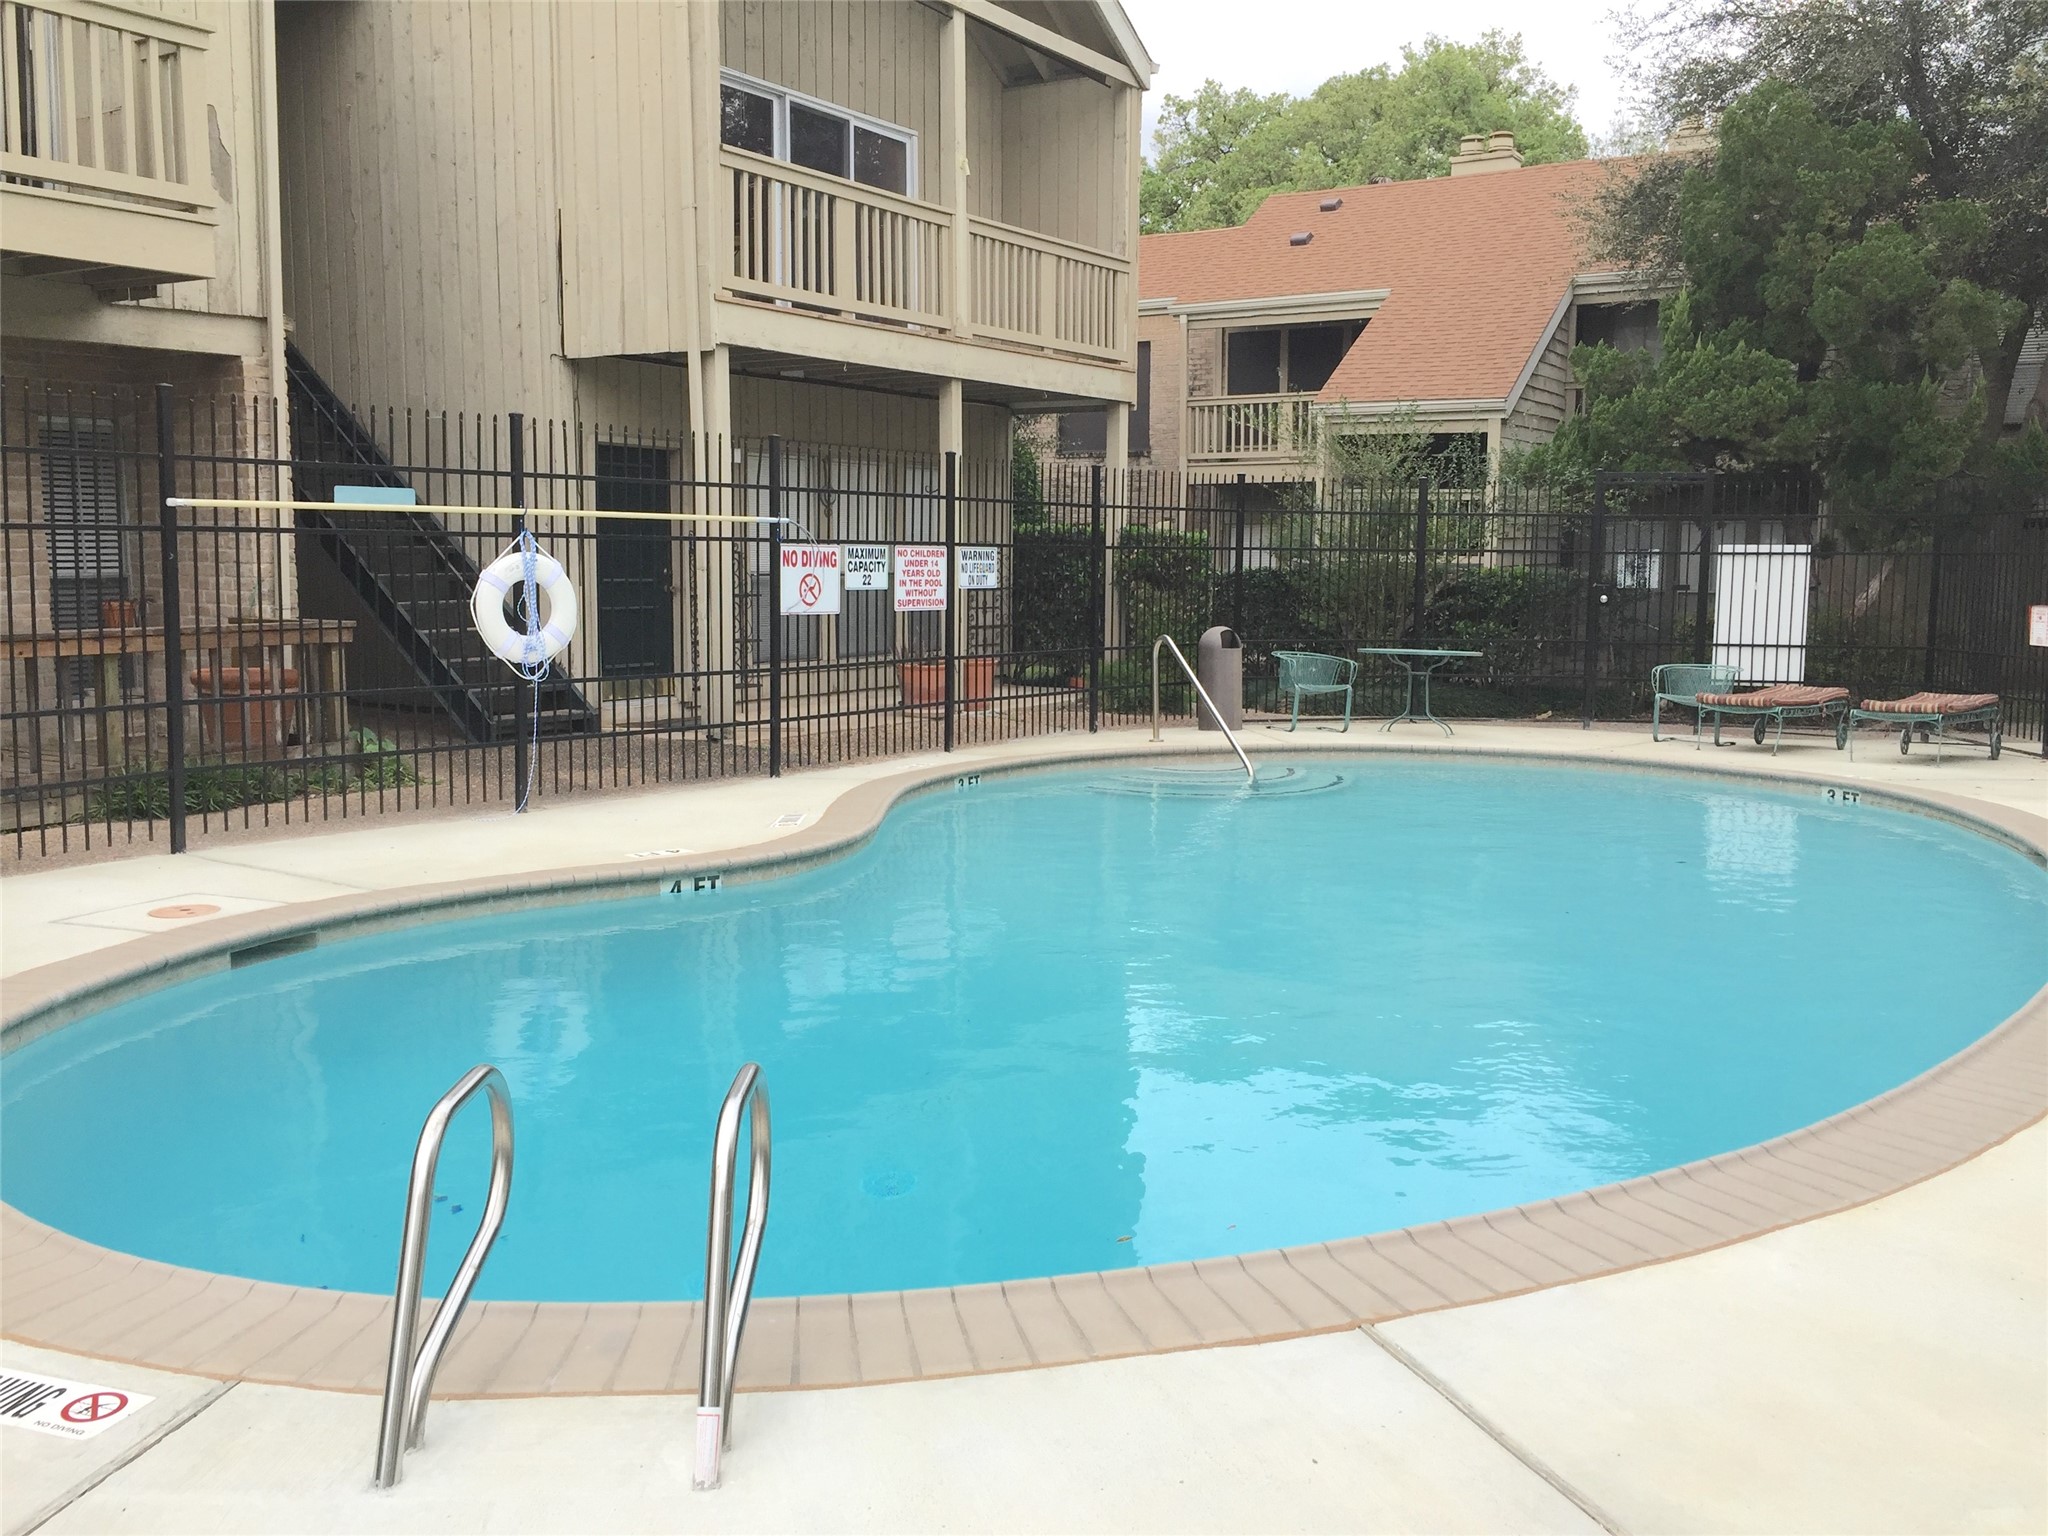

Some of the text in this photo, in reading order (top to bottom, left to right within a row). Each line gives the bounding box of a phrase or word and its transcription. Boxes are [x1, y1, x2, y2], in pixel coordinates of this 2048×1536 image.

[782, 550, 837, 568] NO DIVING
[847, 548, 886, 560] MAXIMUM
[897, 549, 945, 558] NO CHILDREN
[961, 550, 995, 561] WARNING
[847, 561, 887, 573] CAPACITY
[904, 560, 939, 568] UNDER 14
[961, 562, 995, 573] NO LIFEGUARD
[902, 569, 941, 578] YEARS OLD
[862, 574, 872, 586] 22
[899, 579, 943, 587] IN THE POOL
[967, 574, 988, 585] ON DUTY
[905, 589, 938, 597] WITHOUT
[897, 599, 945, 607] SUPERVISION
[967, 775, 980, 786] FT
[1842, 790, 1860, 803] FT
[669, 874, 721, 894] 4 FT
[34, 1420, 86, 1436] NO DIVING
